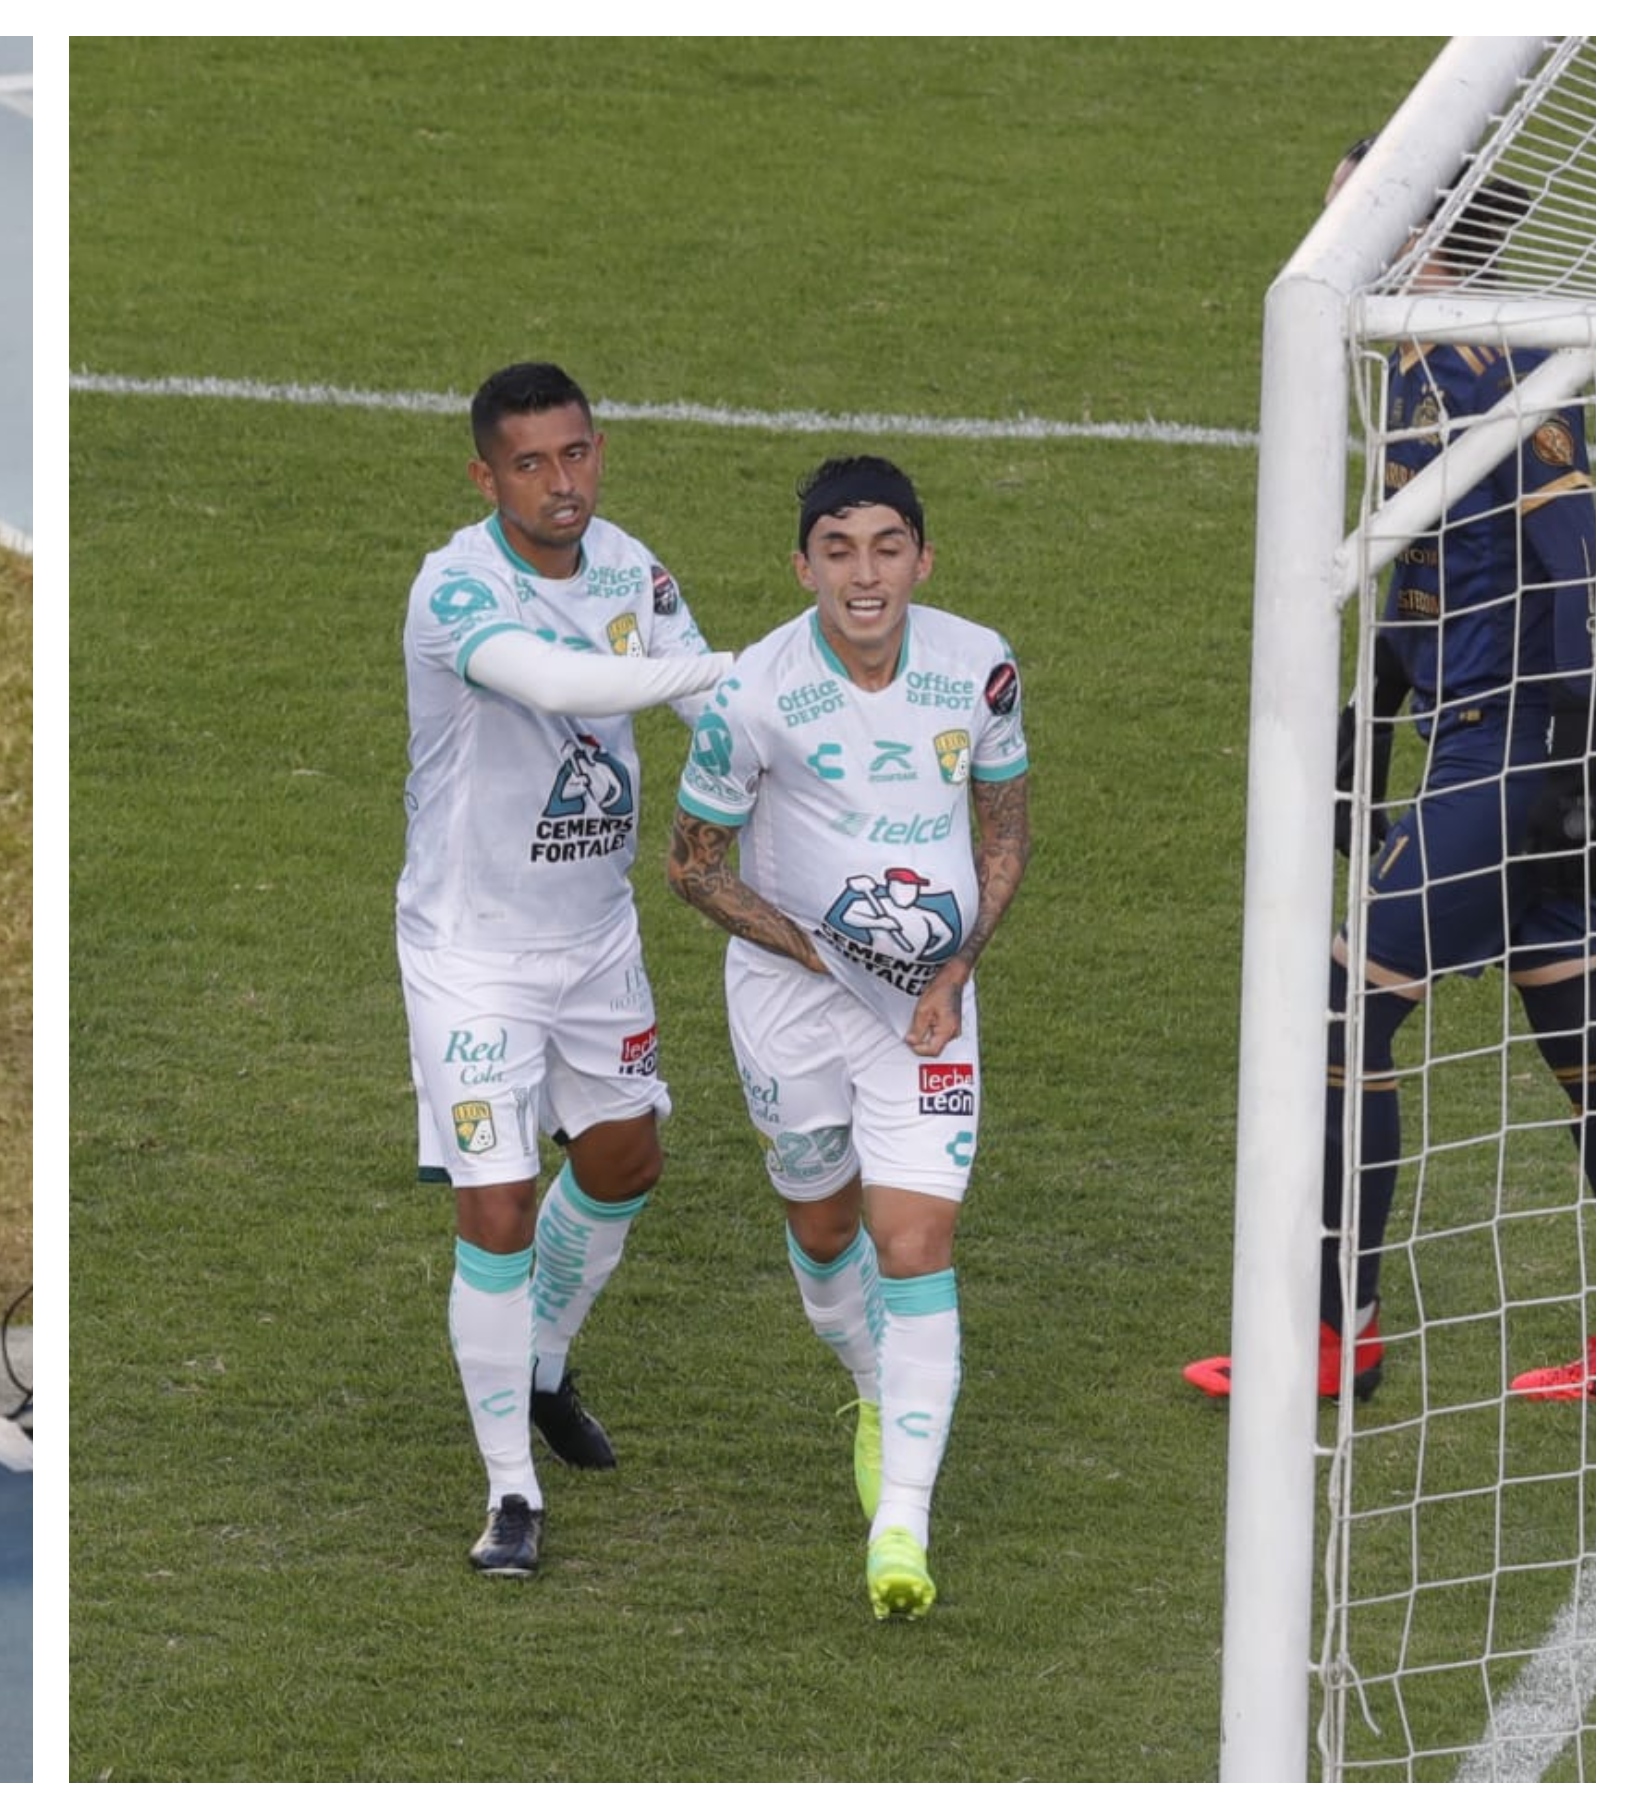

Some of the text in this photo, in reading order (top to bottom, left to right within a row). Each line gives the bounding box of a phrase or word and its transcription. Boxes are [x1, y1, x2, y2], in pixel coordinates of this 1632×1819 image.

[778, 679, 839, 713] Office
[906, 671, 974, 695] Office
[786, 694, 845, 727] DEPOT
[906, 690, 974, 710] DEPOT
[444, 1027, 507, 1063] Red
[460, 1065, 503, 1084] Cola
